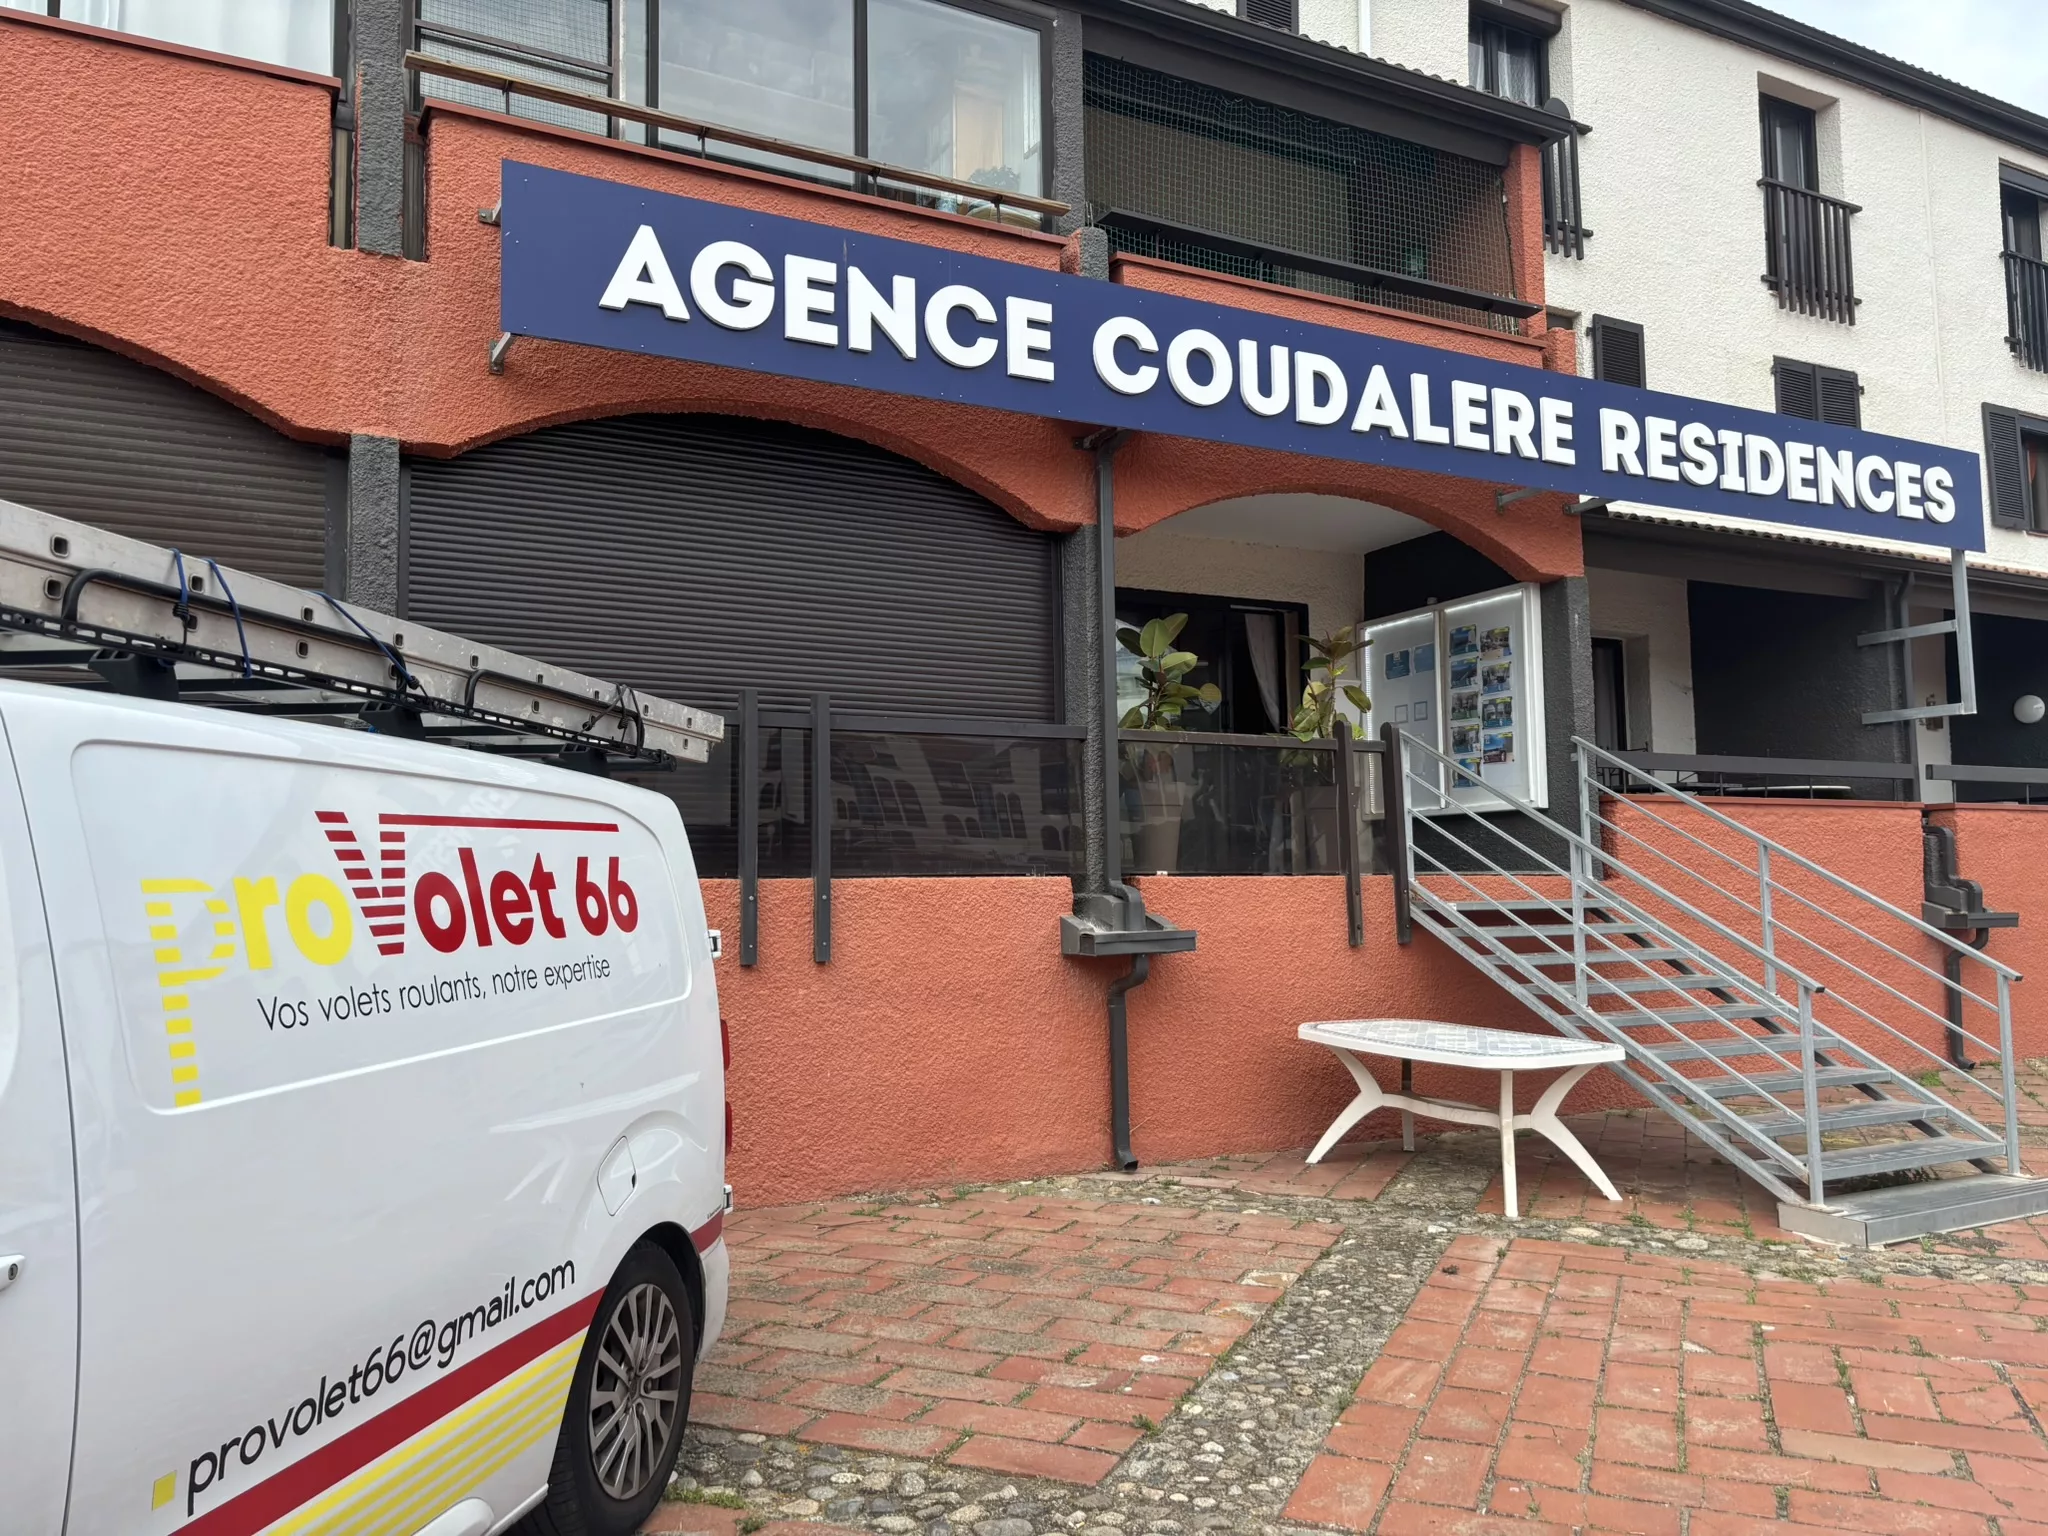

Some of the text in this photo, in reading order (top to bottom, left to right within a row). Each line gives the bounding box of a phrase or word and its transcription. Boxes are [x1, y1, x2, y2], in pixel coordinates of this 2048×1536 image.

[598, 224, 1957, 524] AGENCE COUDALERE RESIDENCES
[575, 856, 639, 937] 66
[257, 953, 612, 1031] Vos volets roulants, notre expertise
[187, 1260, 576, 1518] provolet66@gmail.com
